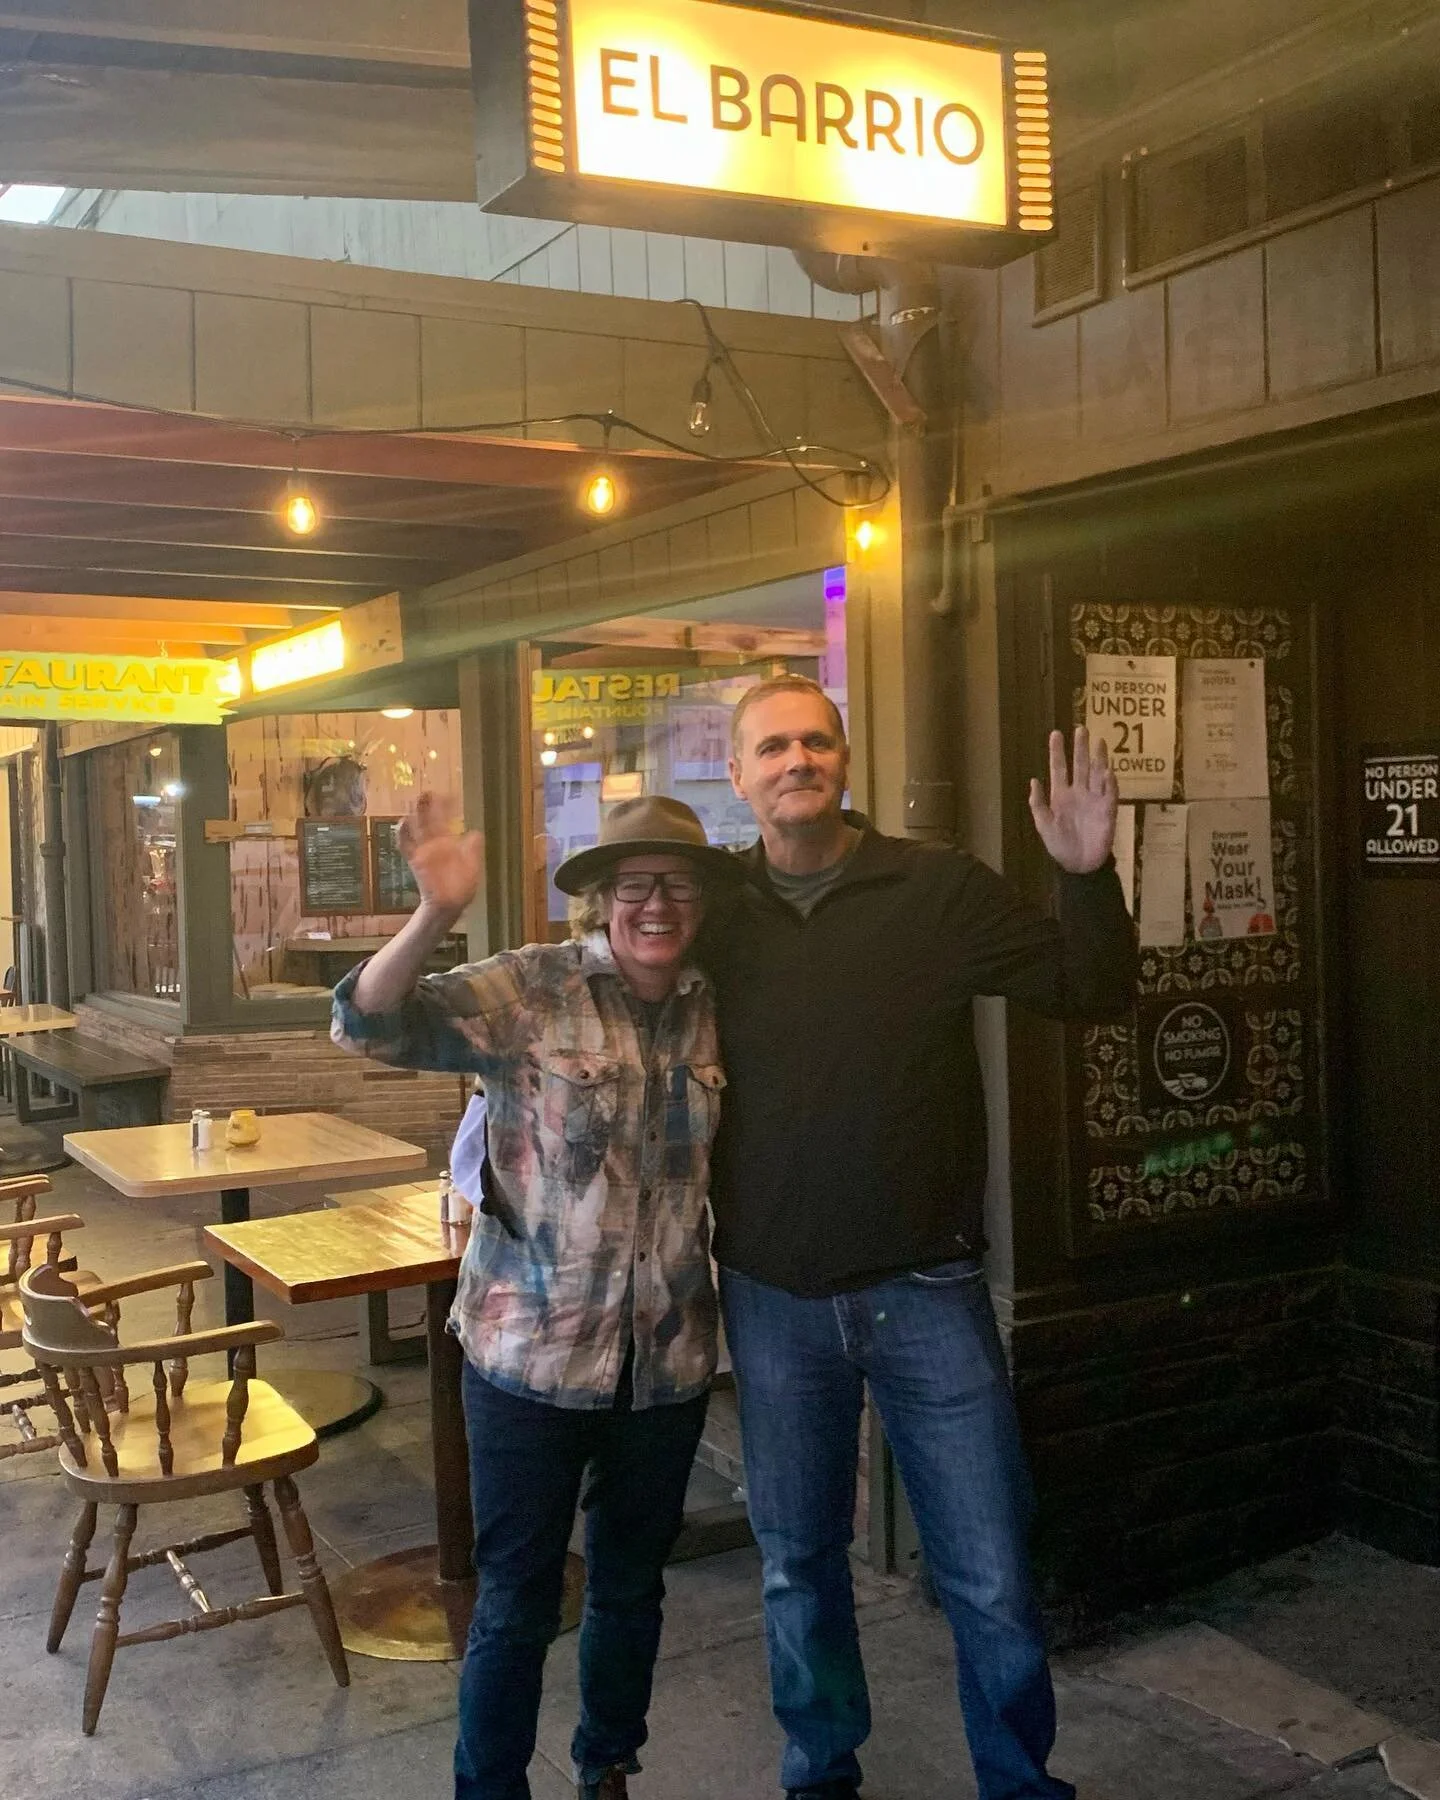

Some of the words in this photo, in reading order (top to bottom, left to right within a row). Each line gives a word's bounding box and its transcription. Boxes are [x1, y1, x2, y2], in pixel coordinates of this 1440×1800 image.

[600, 47, 688, 124] EL
[709, 64, 985, 166] BARRIO
[1092, 681, 1110, 694] NO
[1115, 682, 1167, 695] PERSON
[57, 693, 176, 715] SERVICE
[1092, 696, 1166, 717] UNDER
[1113, 721, 1143, 753] 21
[1111, 758, 1166, 772] LOWED
[1365, 766, 1385, 779] NO
[1388, 763, 1438, 778] PERSON
[1365, 778, 1438, 800] UNDER
[1386, 803, 1418, 836] 21
[1210, 842, 1249, 856] Wear
[1366, 839, 1439, 854] ALLOWED
[1209, 857, 1255, 878] Your
[1205, 876, 1261, 901] Mask!
[1182, 1015, 1202, 1028] NO
